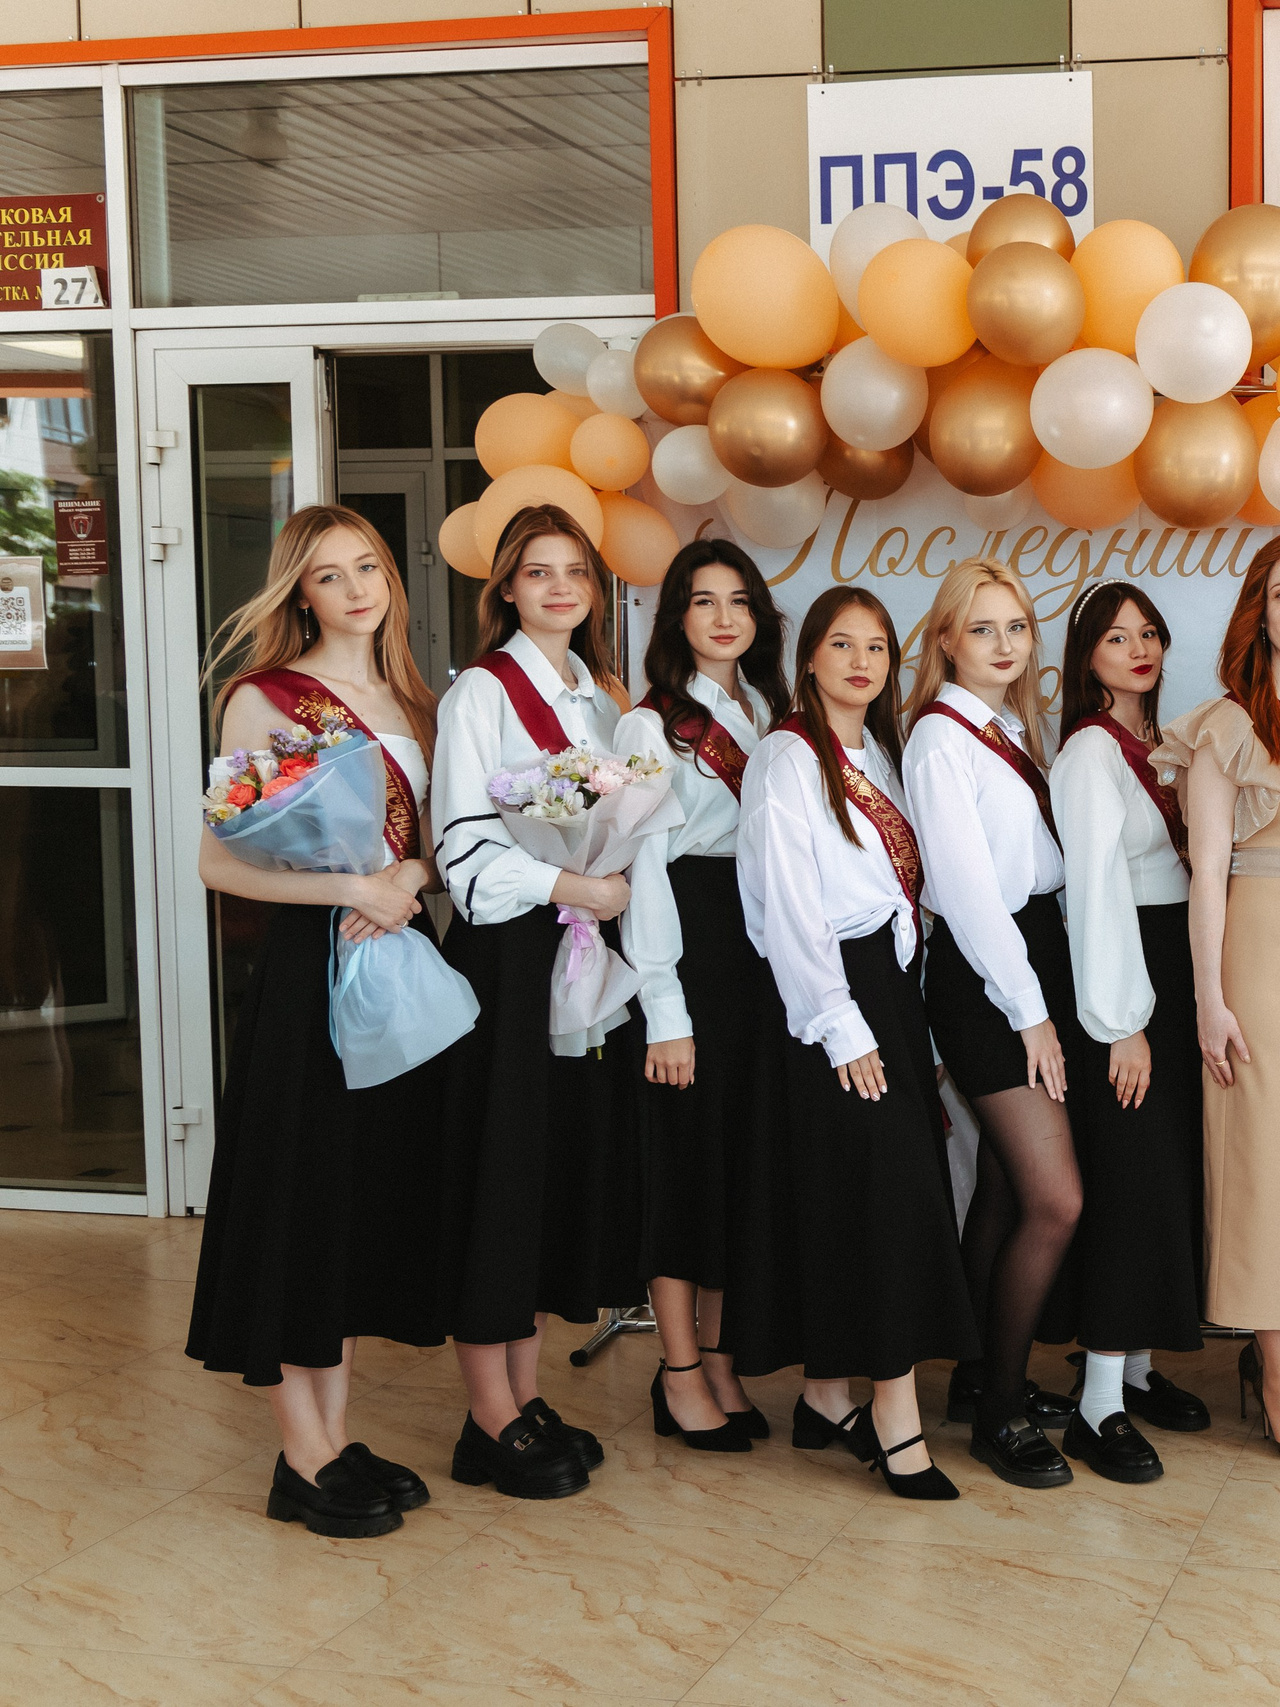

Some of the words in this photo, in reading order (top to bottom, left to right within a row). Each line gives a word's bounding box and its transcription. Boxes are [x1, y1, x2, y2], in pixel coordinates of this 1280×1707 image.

[819, 145, 1089, 226] ППЭ-58
[0, 228, 93, 249] ЕЛЬНАЯ
[0, 252, 65, 272] ССИЯ
